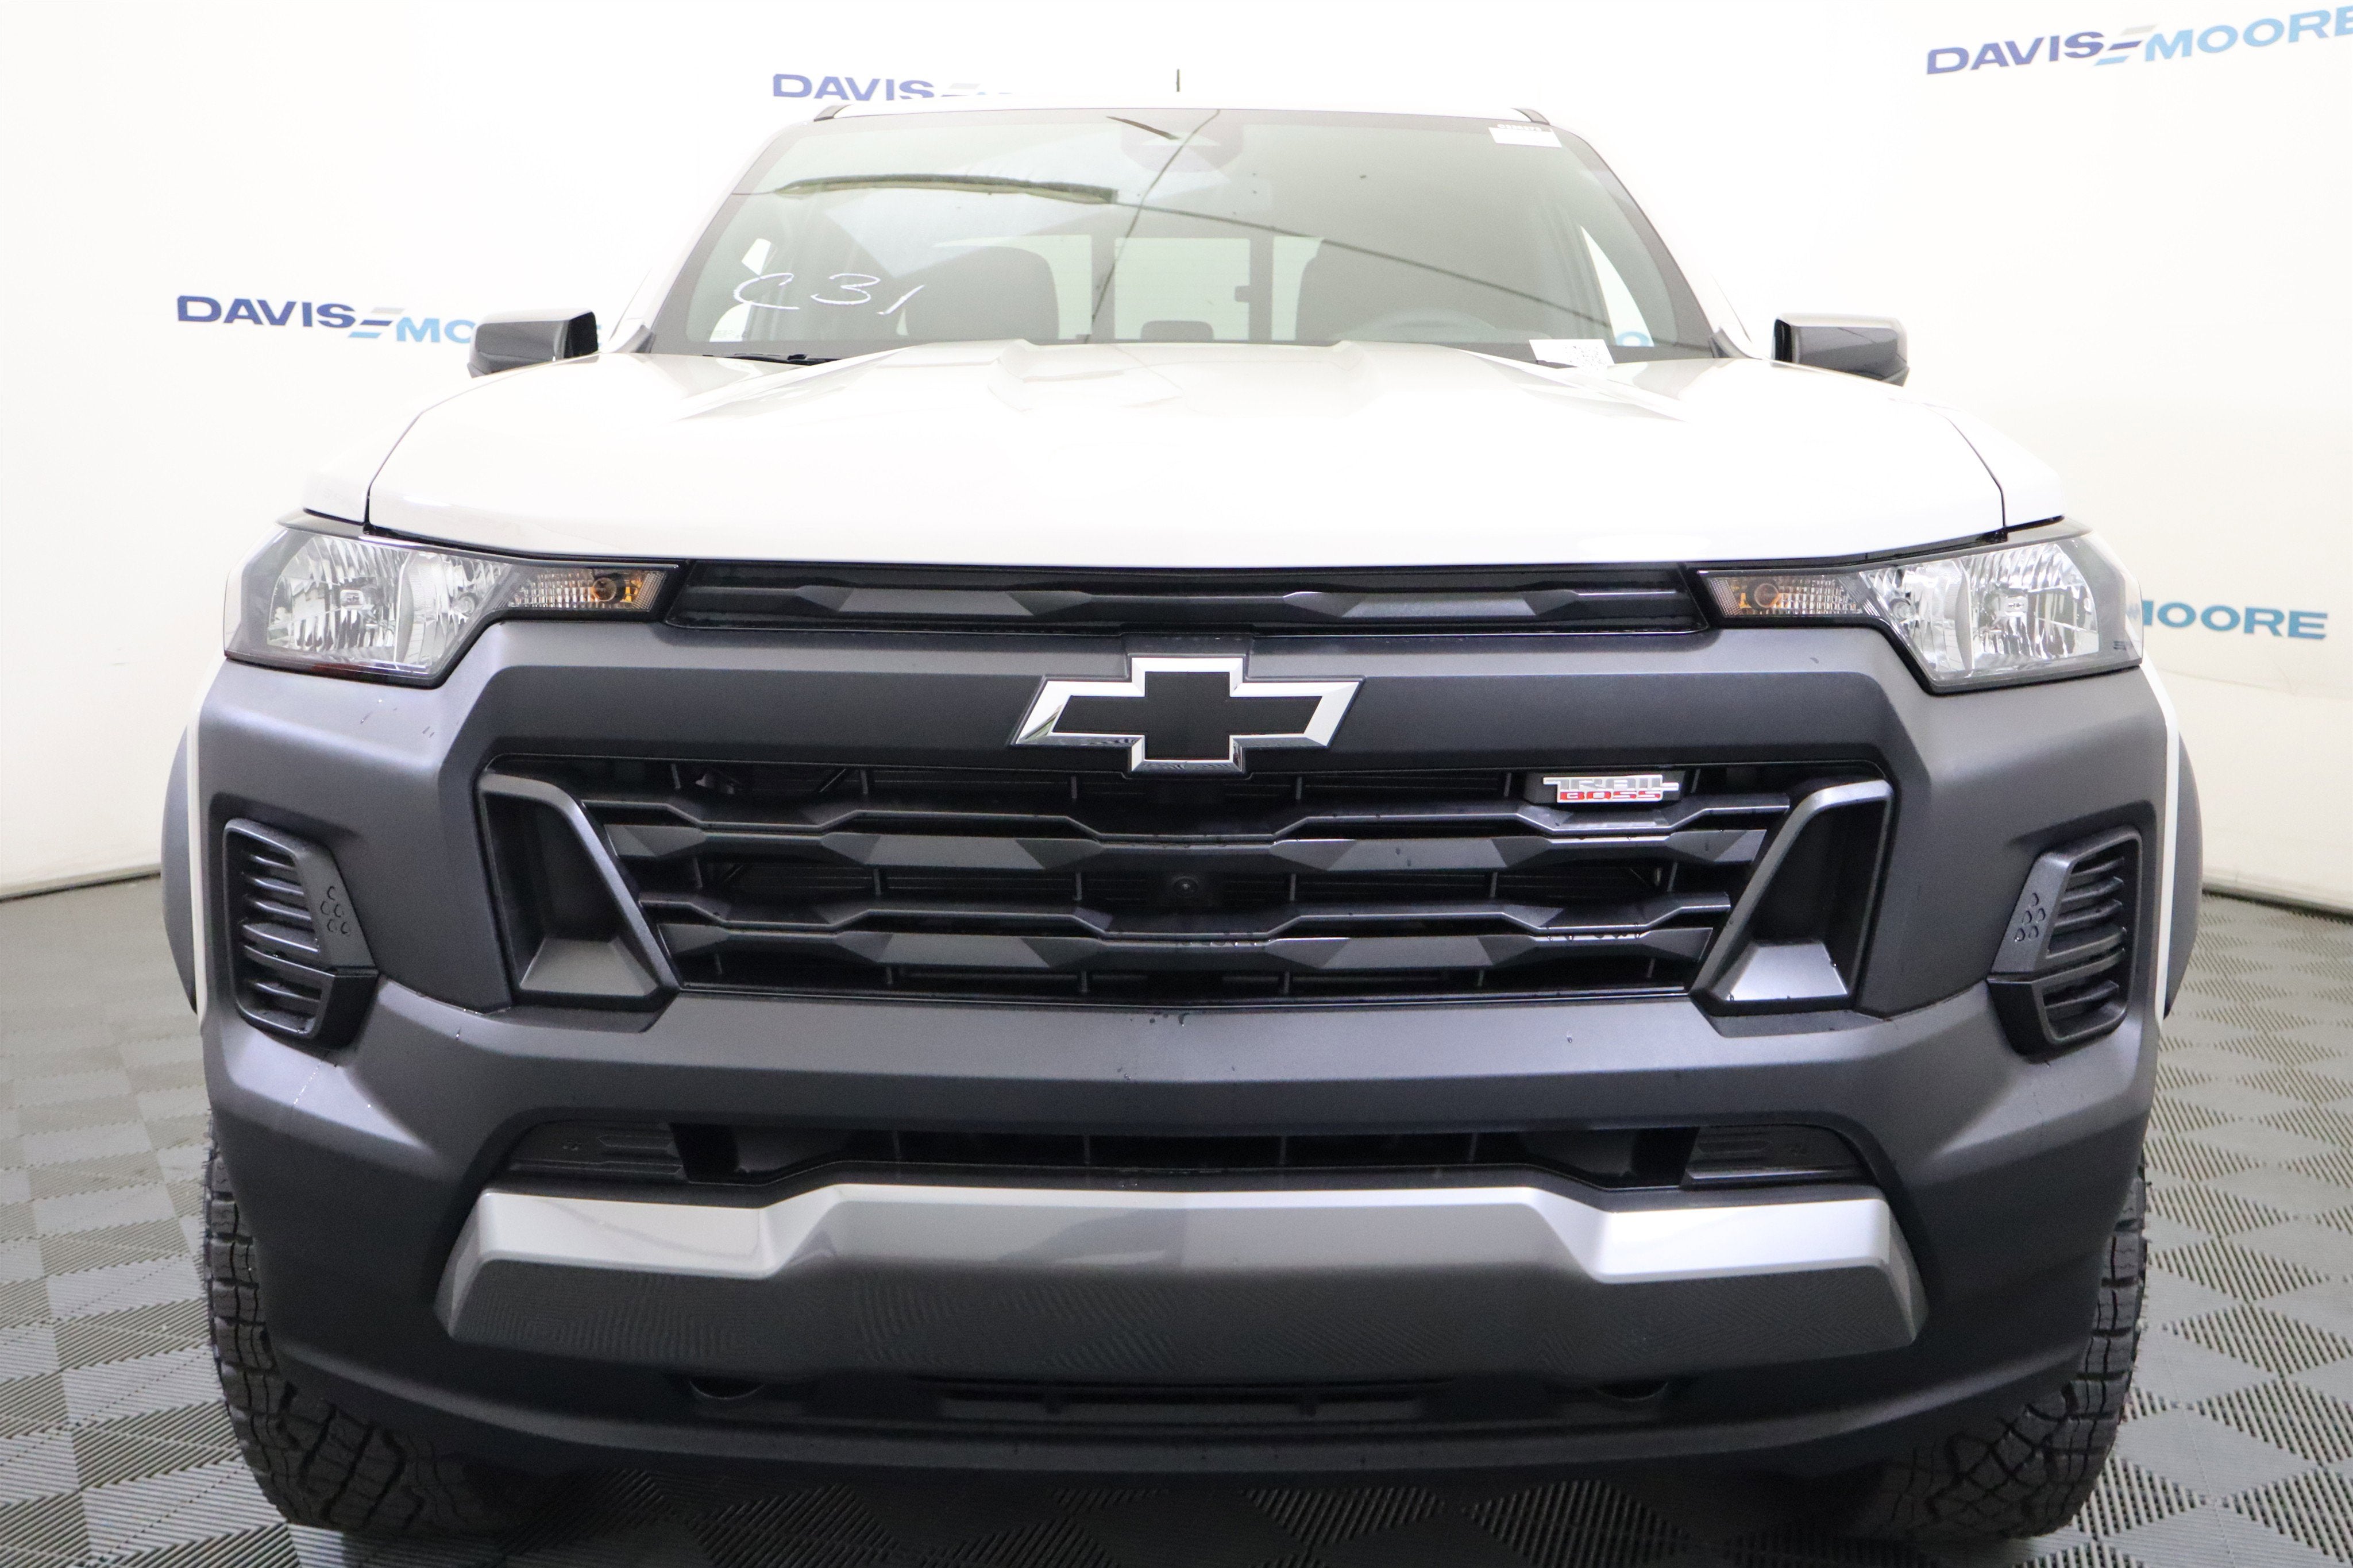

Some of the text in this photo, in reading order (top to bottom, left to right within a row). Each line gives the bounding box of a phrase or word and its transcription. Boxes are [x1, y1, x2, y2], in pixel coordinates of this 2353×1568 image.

[1927, 31, 2105, 75] DAVIS
[772, 74, 934, 101] DAVIS
[177, 295, 356, 328] DAVIS
[2142, 600, 2328, 640] OORE
[1543, 775, 1679, 791] TRAIL
[1558, 790, 1662, 802] BOSS
